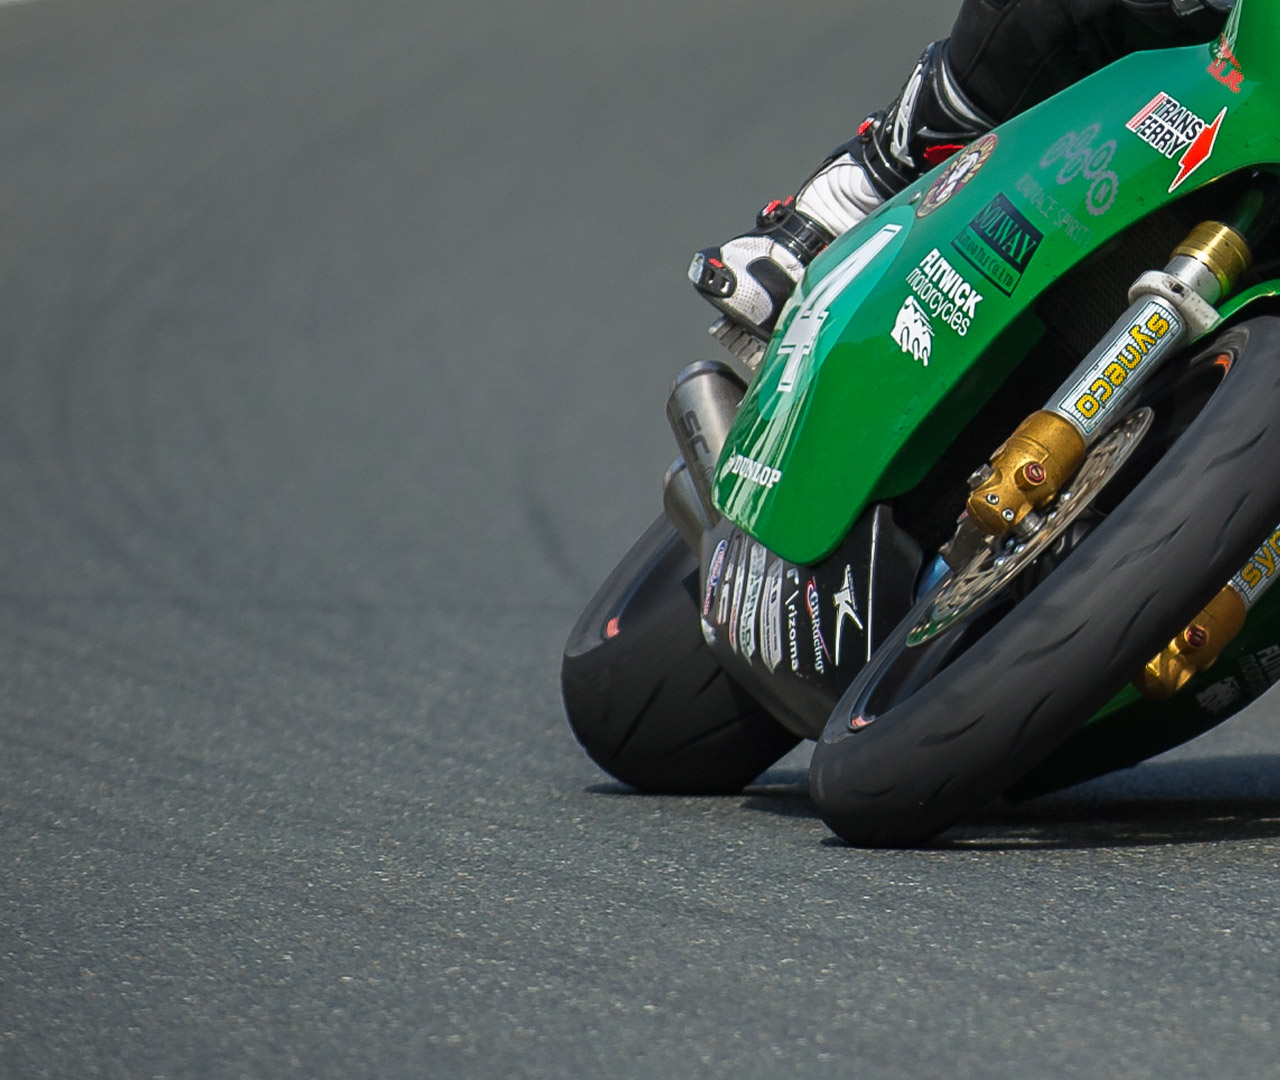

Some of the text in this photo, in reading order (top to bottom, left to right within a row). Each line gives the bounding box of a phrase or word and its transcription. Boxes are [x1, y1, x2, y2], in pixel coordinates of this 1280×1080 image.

[1139, 114, 1187, 157] FERRY
[1155, 98, 1203, 141] TRANS
[975, 198, 1037, 265] SOLWAY
[776, 223, 903, 393] 4
[905, 267, 970, 336] motorcycles
[919, 248, 983, 319] FLITWICK
[1075, 312, 1170, 419] syneco
[680, 410, 709, 461] SC
[731, 454, 782, 488] DUNLOP
[787, 604, 800, 671] rizoma
